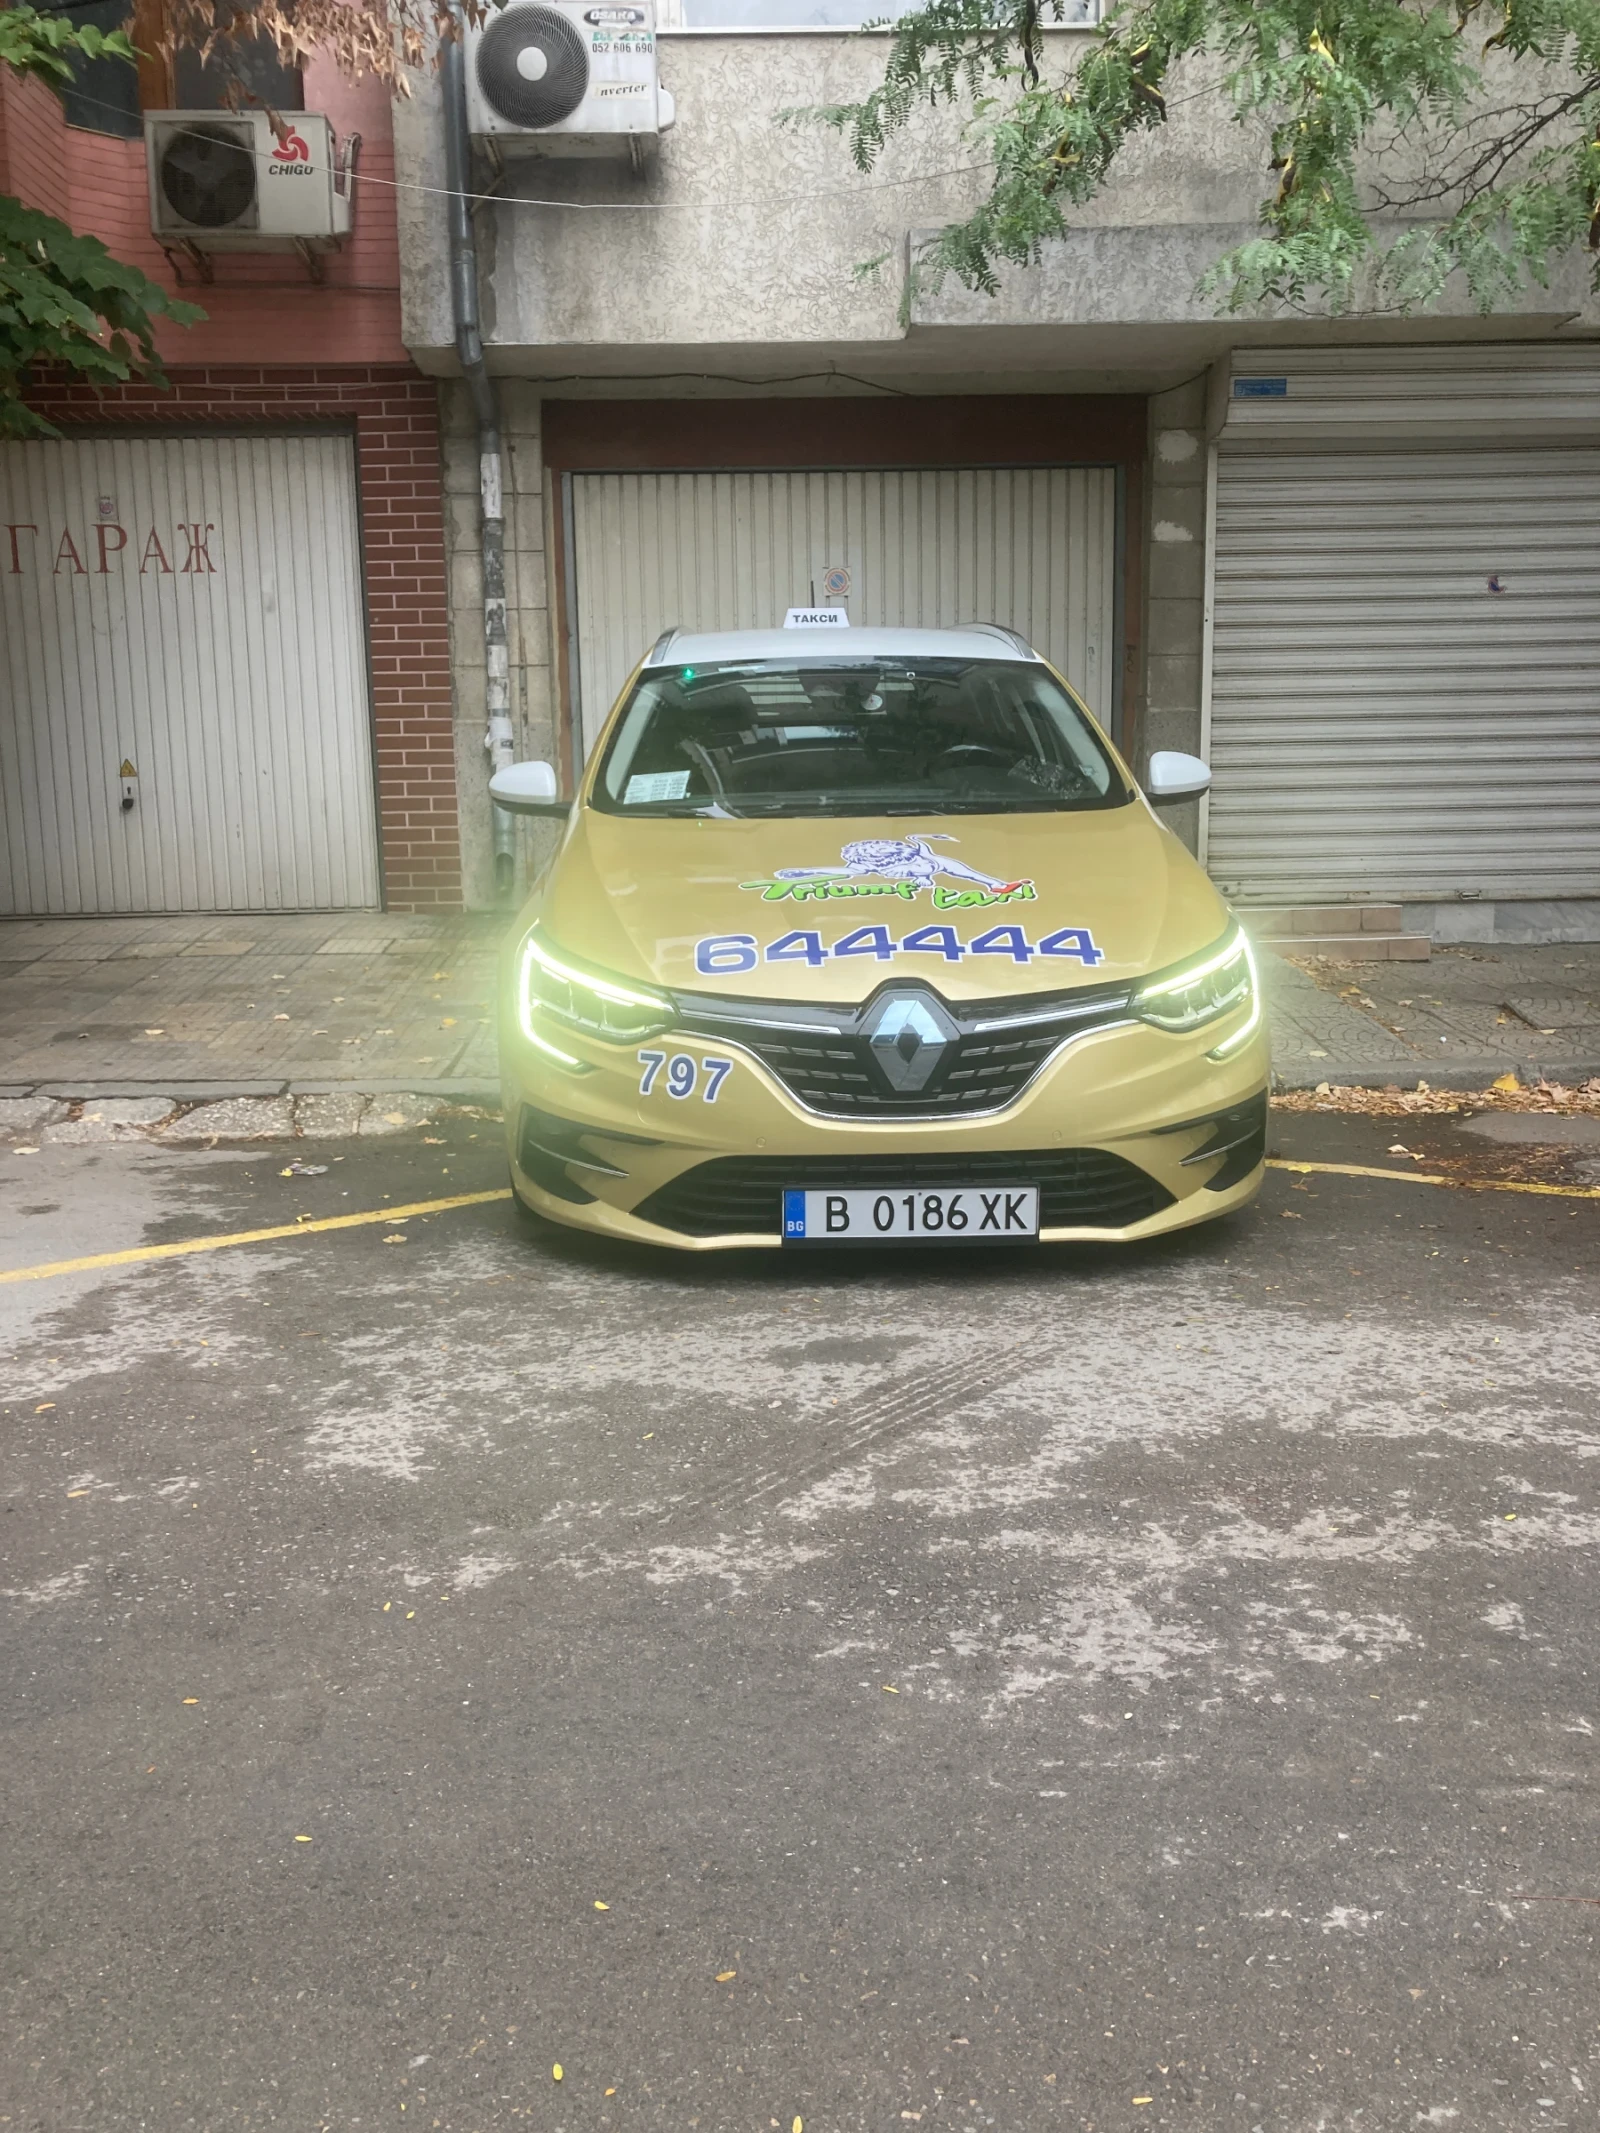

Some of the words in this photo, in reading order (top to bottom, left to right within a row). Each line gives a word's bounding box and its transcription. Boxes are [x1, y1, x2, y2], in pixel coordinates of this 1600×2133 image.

[590, 10, 637, 21] OSAKA
[592, 42, 609, 53] 052
[613, 42, 632, 53] 606
[635, 42, 653, 54] 690
[3, 523, 218, 574] ГАРАЖ
[792, 614, 838, 623] ТАКСИ
[739, 873, 921, 901] Triumf
[932, 879, 1037, 910] taxi
[694, 923, 1106, 976] 644444
[638, 1050, 734, 1104] 797
[787, 1220, 804, 1232] BG
[825, 1196, 850, 1232] B
[873, 1194, 969, 1232] 0186
[978, 1193, 1028, 1230] XK
